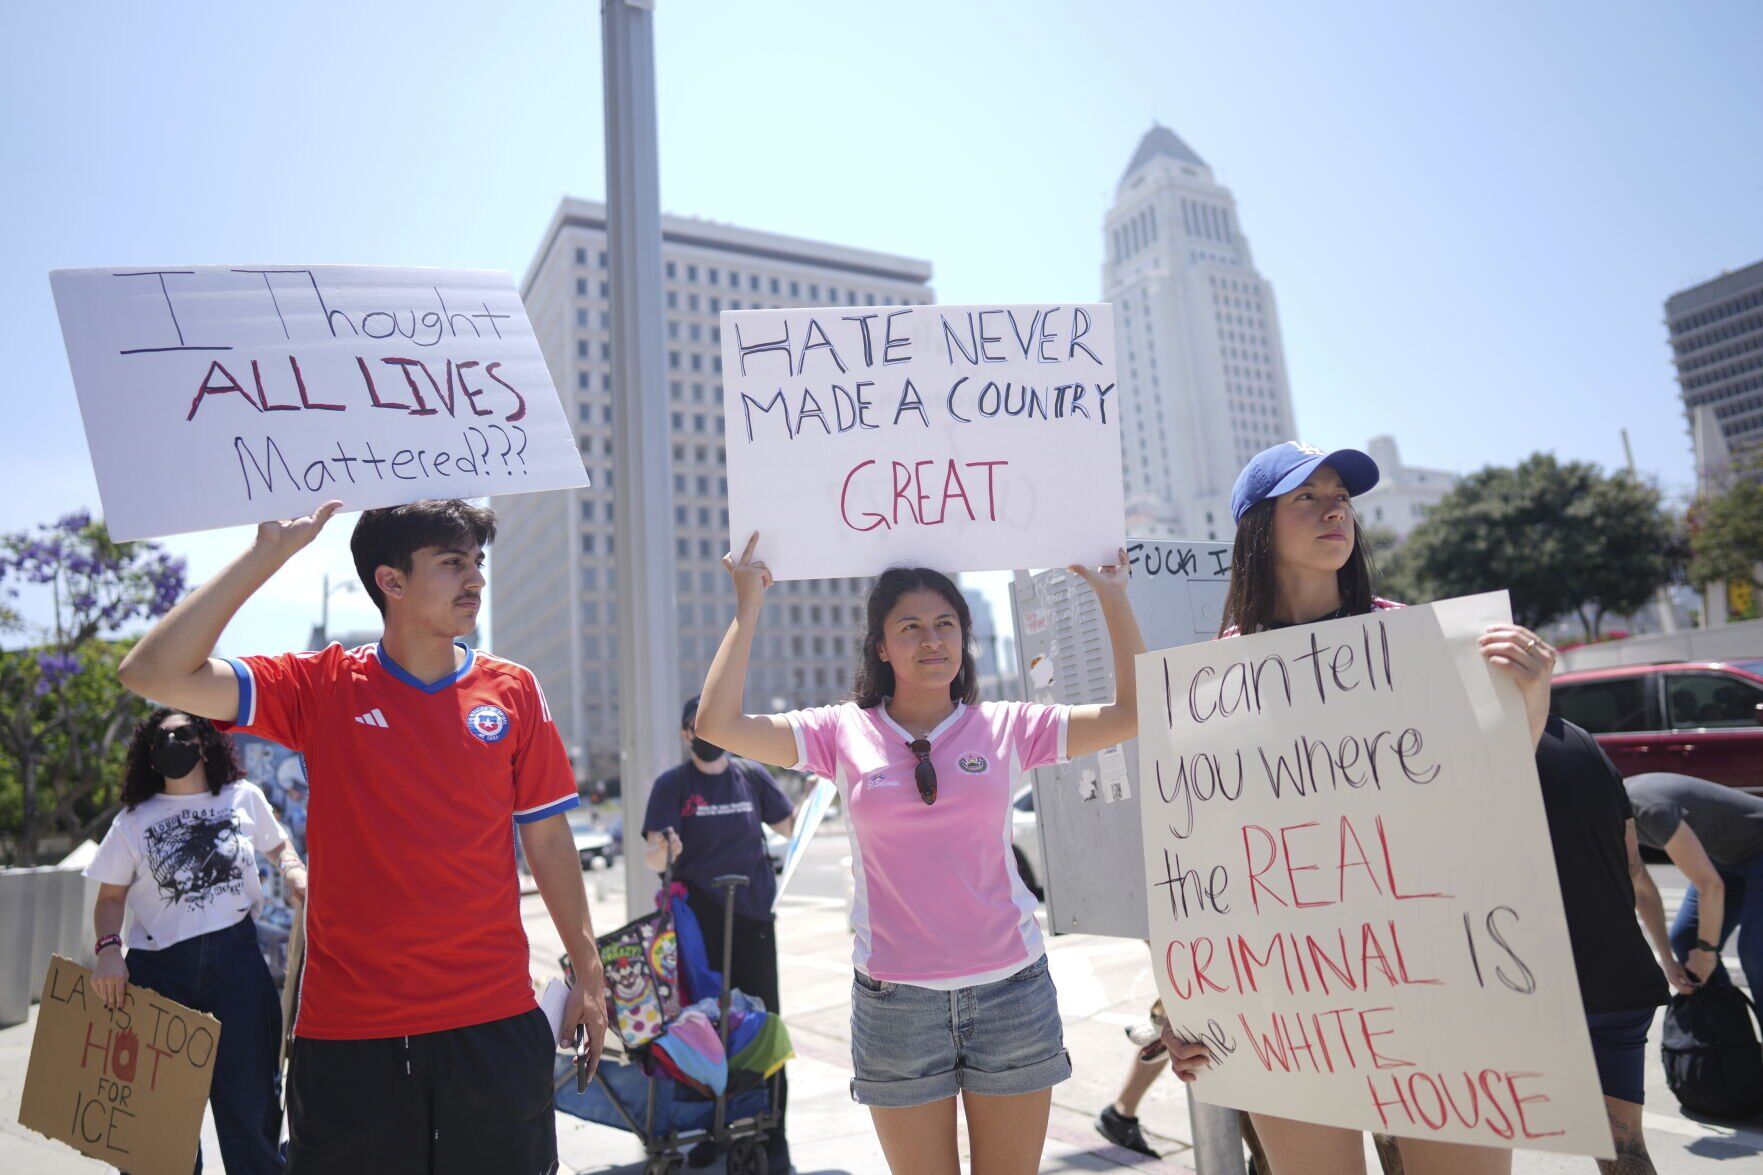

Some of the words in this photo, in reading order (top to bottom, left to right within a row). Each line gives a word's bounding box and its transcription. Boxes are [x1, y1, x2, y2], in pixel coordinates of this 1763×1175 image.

[112, 271, 233, 355] I
[230, 269, 511, 347] Thought
[735, 310, 914, 377] HATE
[941, 306, 1103, 366] NEVER
[186, 355, 347, 422] ALL
[355, 356, 527, 422] LIVES
[740, 381, 881, 444] MADE
[893, 377, 930, 428] A
[946, 377, 1116, 424] COUNTRY
[233, 425, 528, 501] Mattered???
[840, 458, 1009, 532] GREAT
[1163, 656, 1173, 730] I
[1188, 653, 1293, 724] can
[1293, 620, 1394, 704] tell
[1155, 748, 1243, 839] you
[1257, 727, 1442, 800] where
[1154, 847, 1232, 922] the
[1241, 814, 1456, 916] REAL
[1165, 919, 1446, 1001] CRIMINAL
[1462, 905, 1537, 995] IS
[50, 968, 86, 1011] LA
[149, 1002, 214, 1069] TOO
[1238, 1006, 1417, 1074] WHITE
[80, 1021, 174, 1092] HOT
[97, 1077, 132, 1108] FOR
[71, 1091, 136, 1154] ICE
[1366, 1068, 1566, 1140] HOUSE
